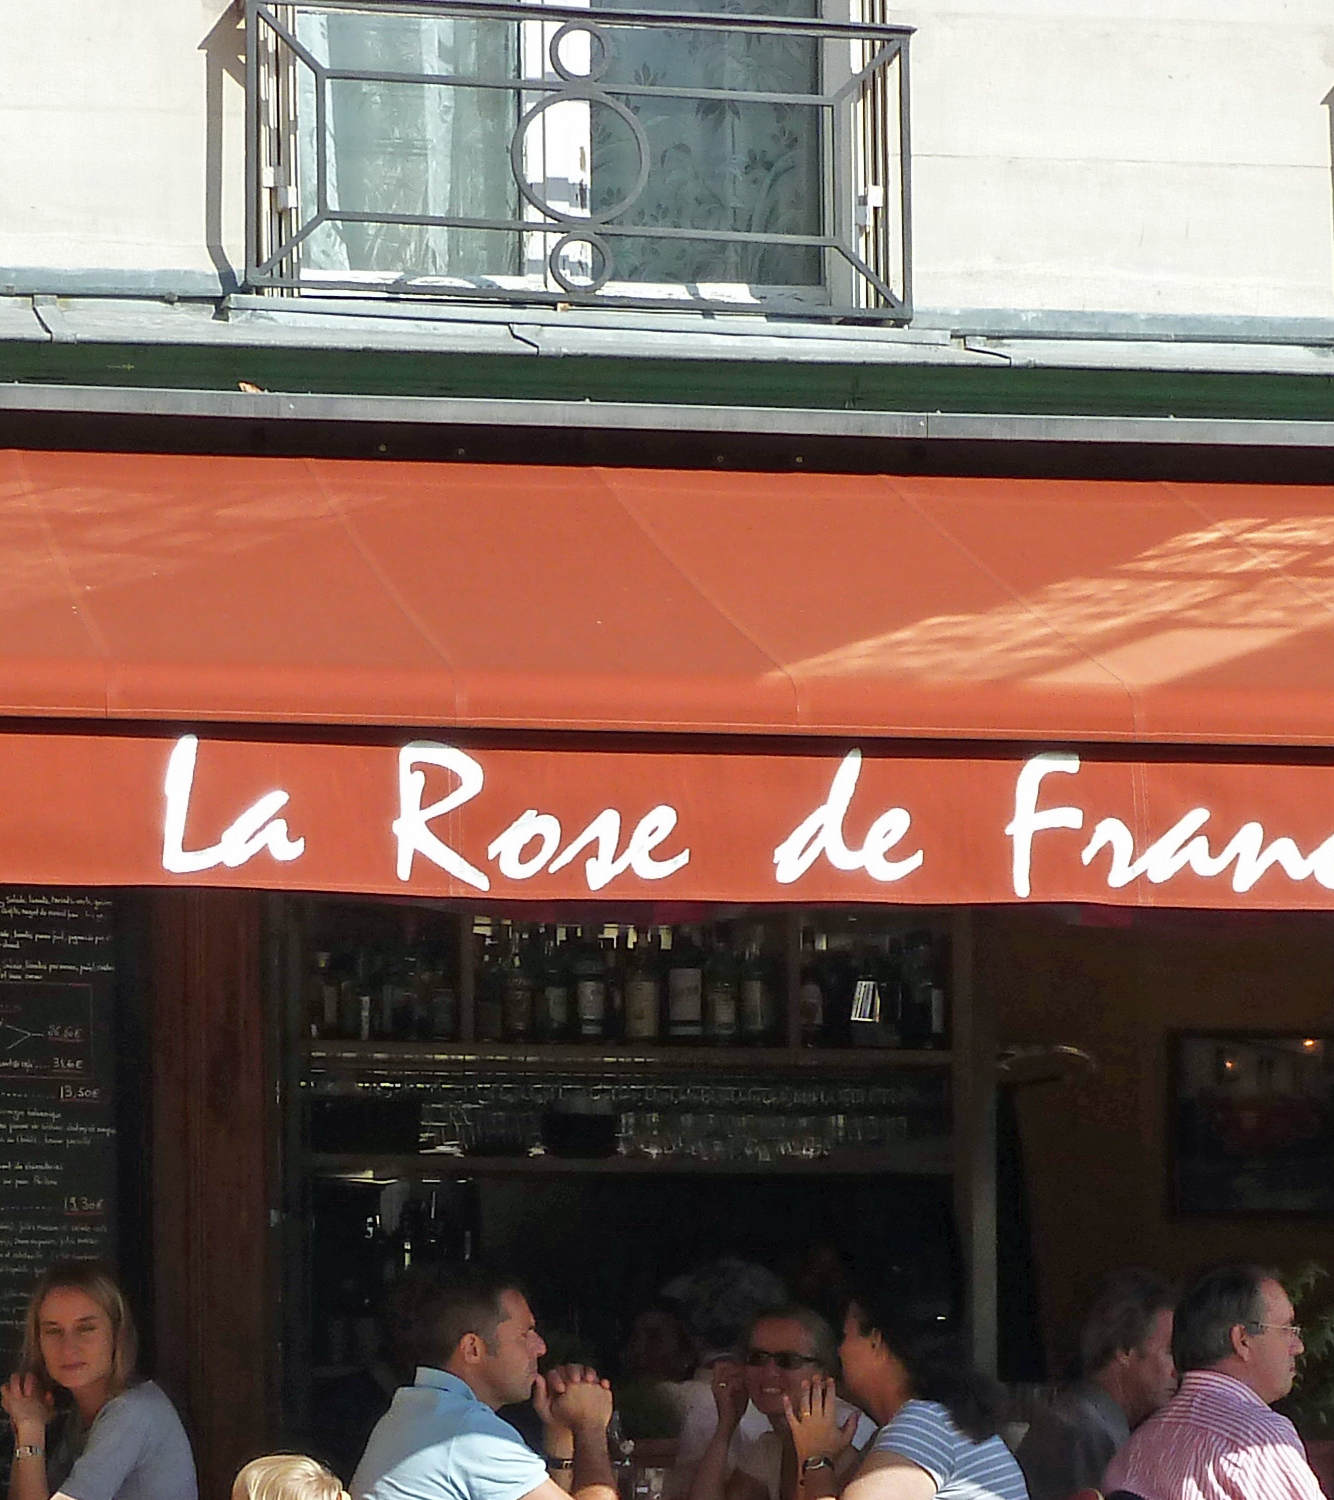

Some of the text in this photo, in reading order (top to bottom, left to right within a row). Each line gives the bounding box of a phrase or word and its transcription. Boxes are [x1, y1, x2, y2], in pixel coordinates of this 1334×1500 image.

[163, 733, 304, 873] La
[392, 741, 689, 891] Rose
[773, 747, 923, 883] de
